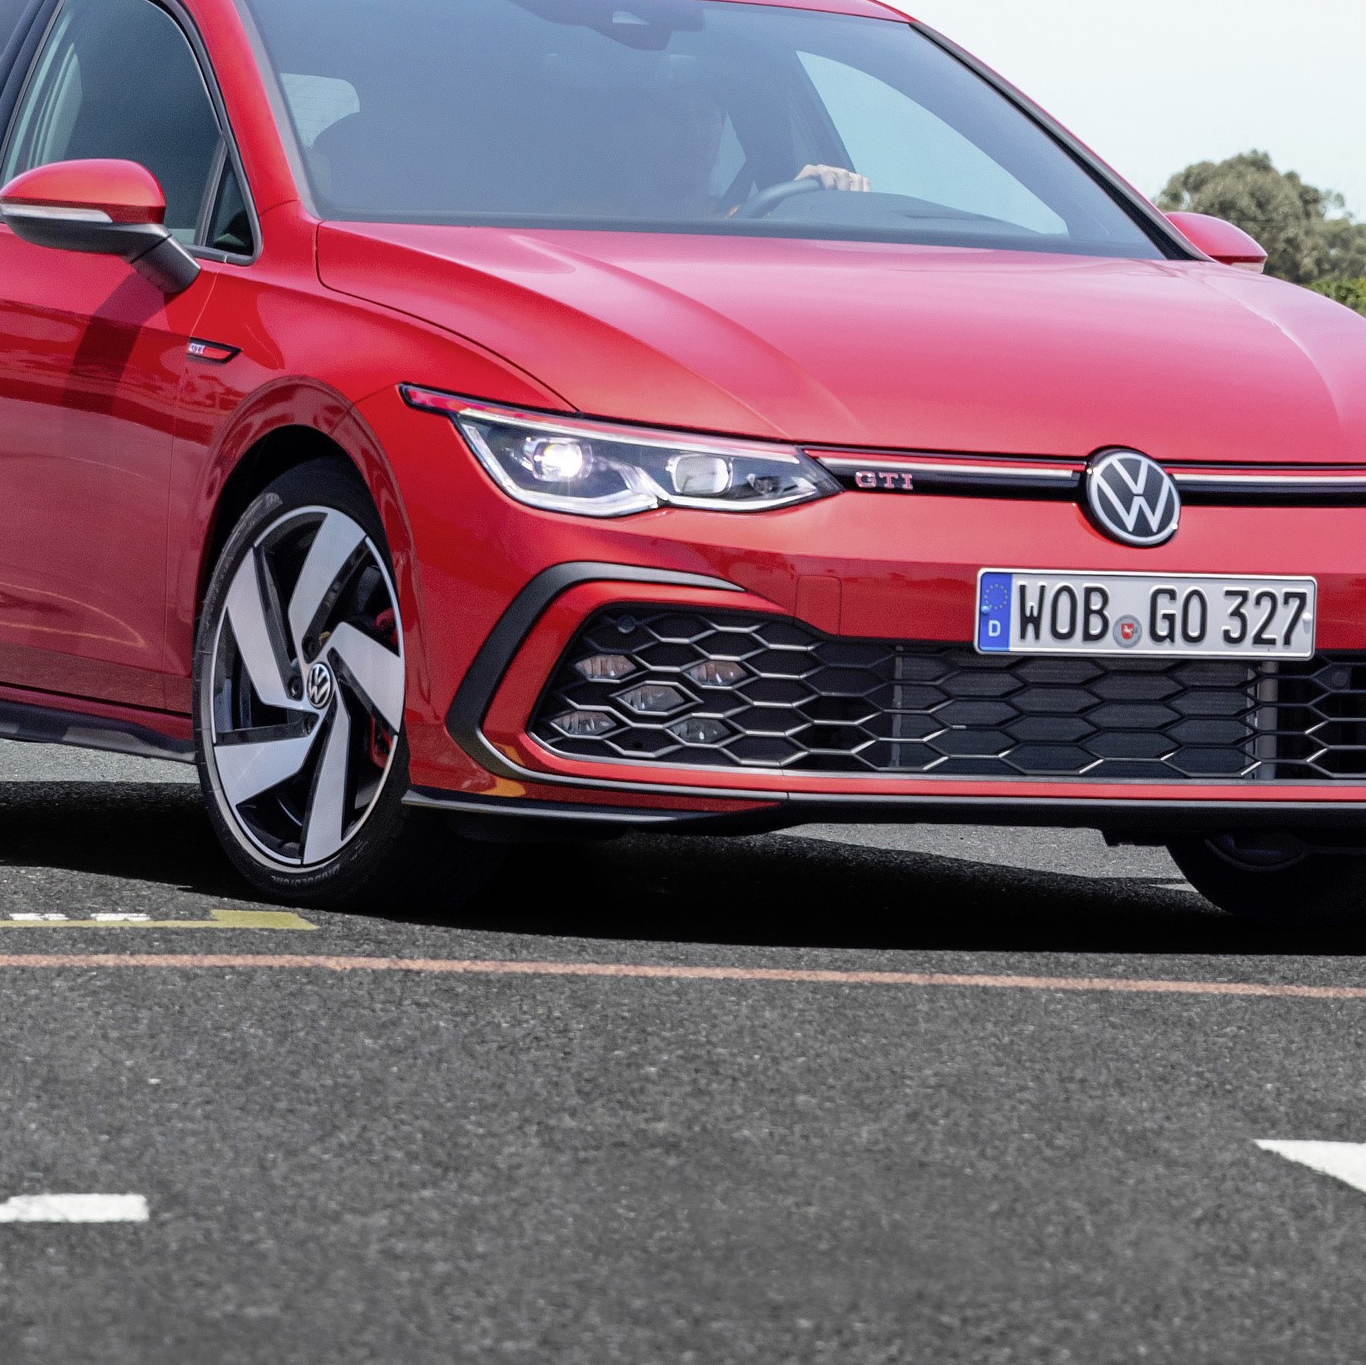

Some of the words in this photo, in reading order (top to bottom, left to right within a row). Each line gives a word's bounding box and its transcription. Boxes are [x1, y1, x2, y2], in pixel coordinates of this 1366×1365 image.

[856, 471, 913, 490] GTI
[1018, 583, 1110, 642] WOB
[1149, 586, 1208, 644] GO
[1222, 589, 1308, 645] 327
[988, 620, 1001, 637] D
